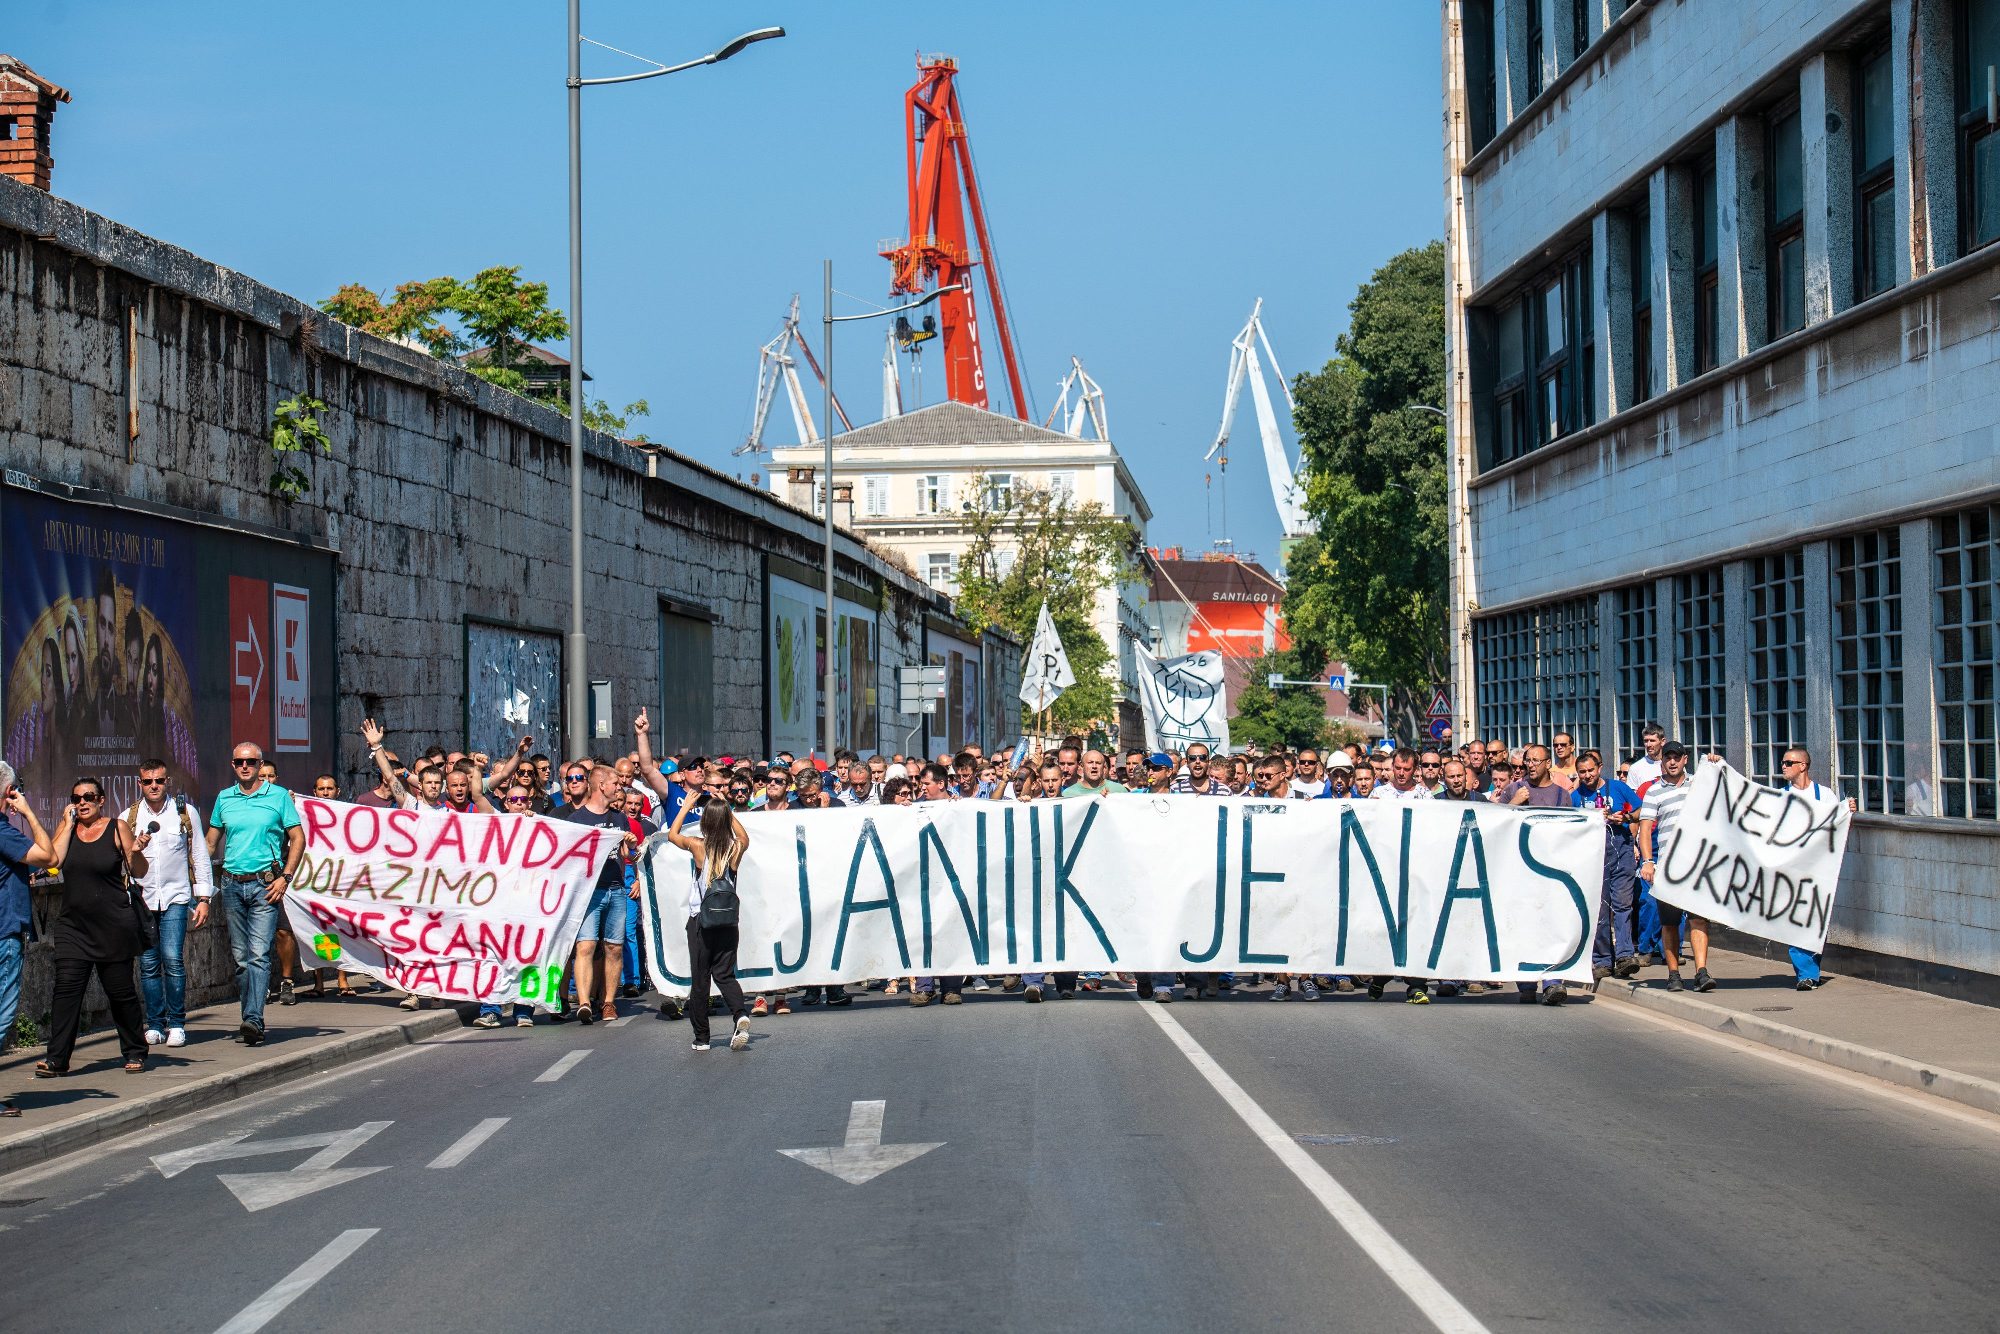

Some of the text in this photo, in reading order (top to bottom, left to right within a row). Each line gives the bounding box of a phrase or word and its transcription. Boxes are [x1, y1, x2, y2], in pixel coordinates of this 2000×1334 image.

[43, 519, 74, 554] ARENA
[1212, 591, 1268, 602] SANTIAGO
[1185, 655, 1208, 668] 56
[280, 695, 306, 719] Kaufland
[303, 799, 601, 878] ROSANDA
[1704, 765, 1840, 854] NEDA
[291, 852, 566, 916] DOLAZIMO U
[1180, 804, 1289, 964] JE
[1335, 803, 1591, 973] NAS
[1663, 828, 1832, 940] UKRADEN
